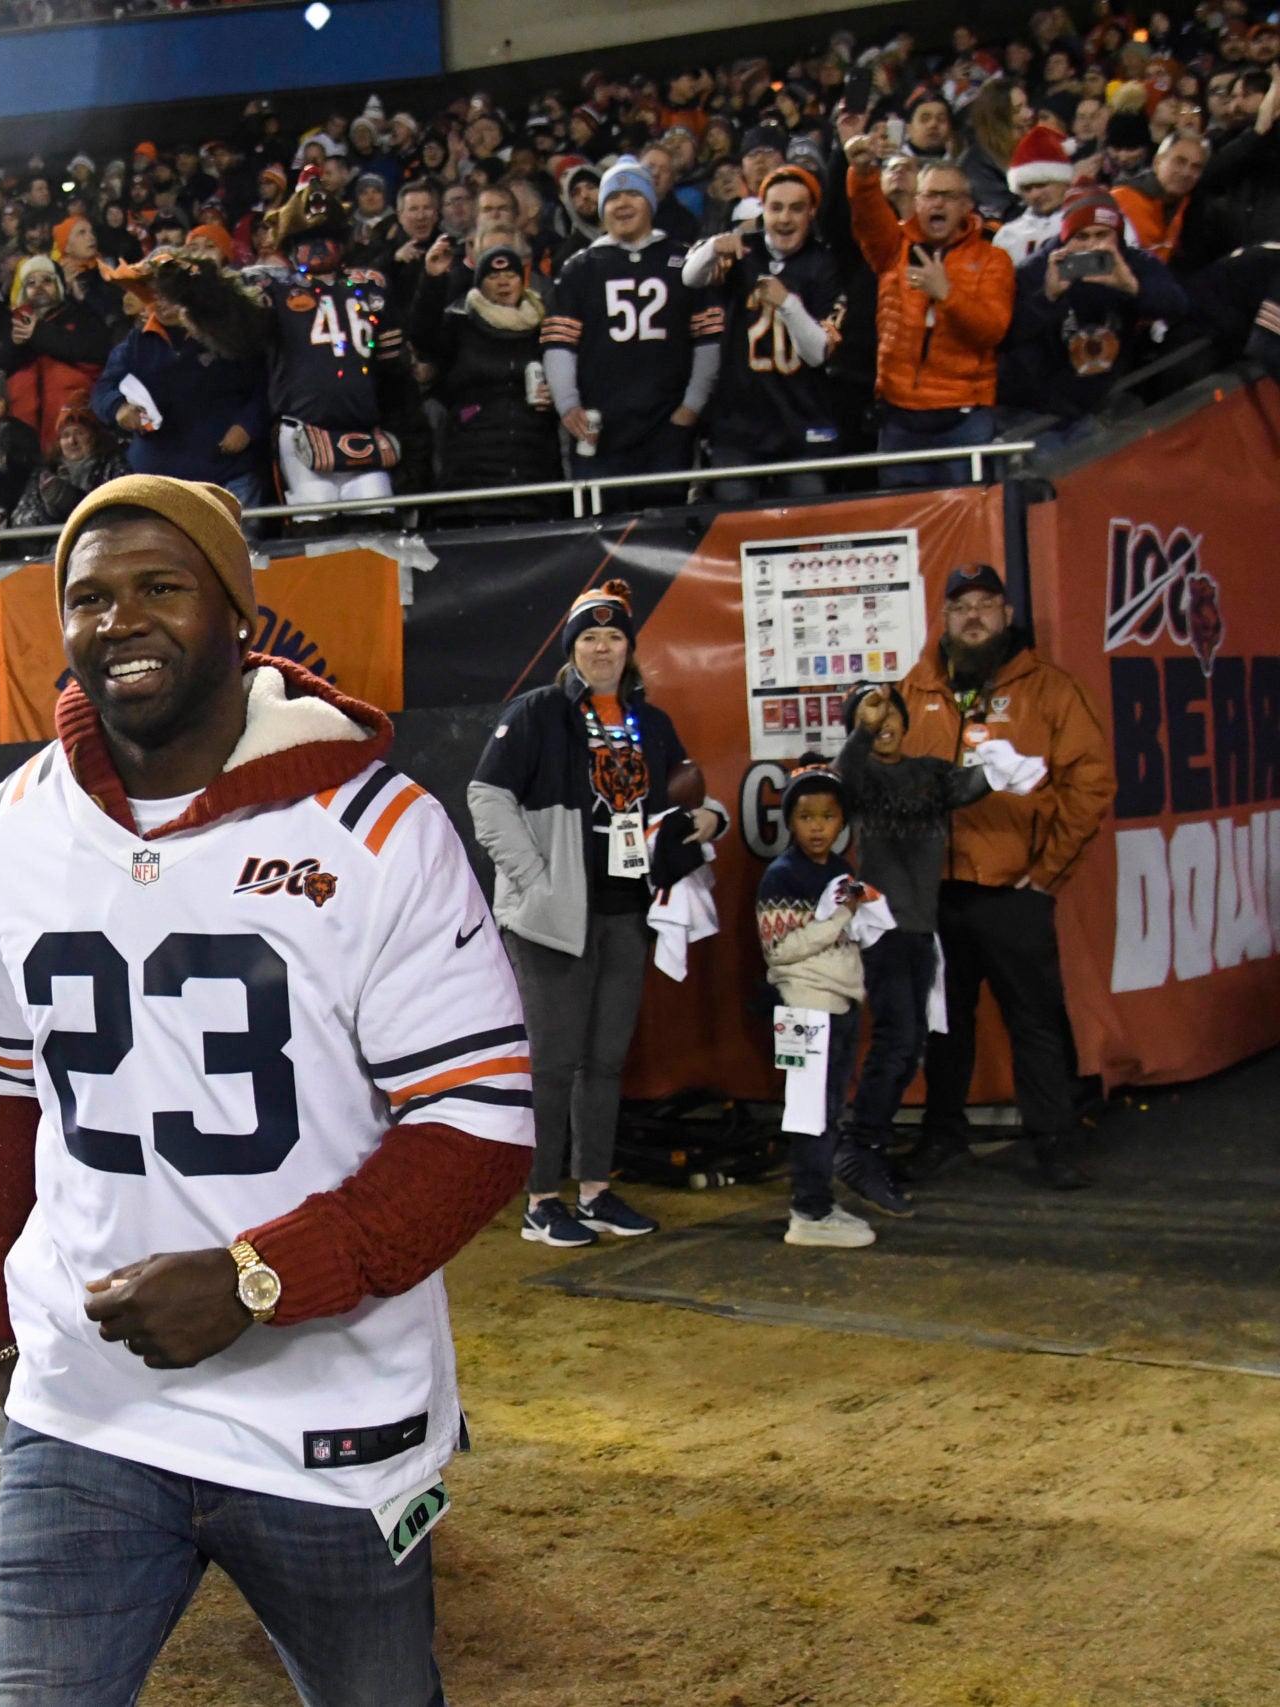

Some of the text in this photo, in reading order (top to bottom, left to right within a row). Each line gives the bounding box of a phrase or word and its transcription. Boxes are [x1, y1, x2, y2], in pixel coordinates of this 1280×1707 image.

[310, 294, 375, 359] 46
[605, 277, 668, 343] 52
[133, 863, 157, 882] NFL
[233, 856, 321, 896] 100
[1111, 808, 1280, 994] DOW
[23, 930, 301, 1177] 23
[404, 1502, 430, 1538] 10
